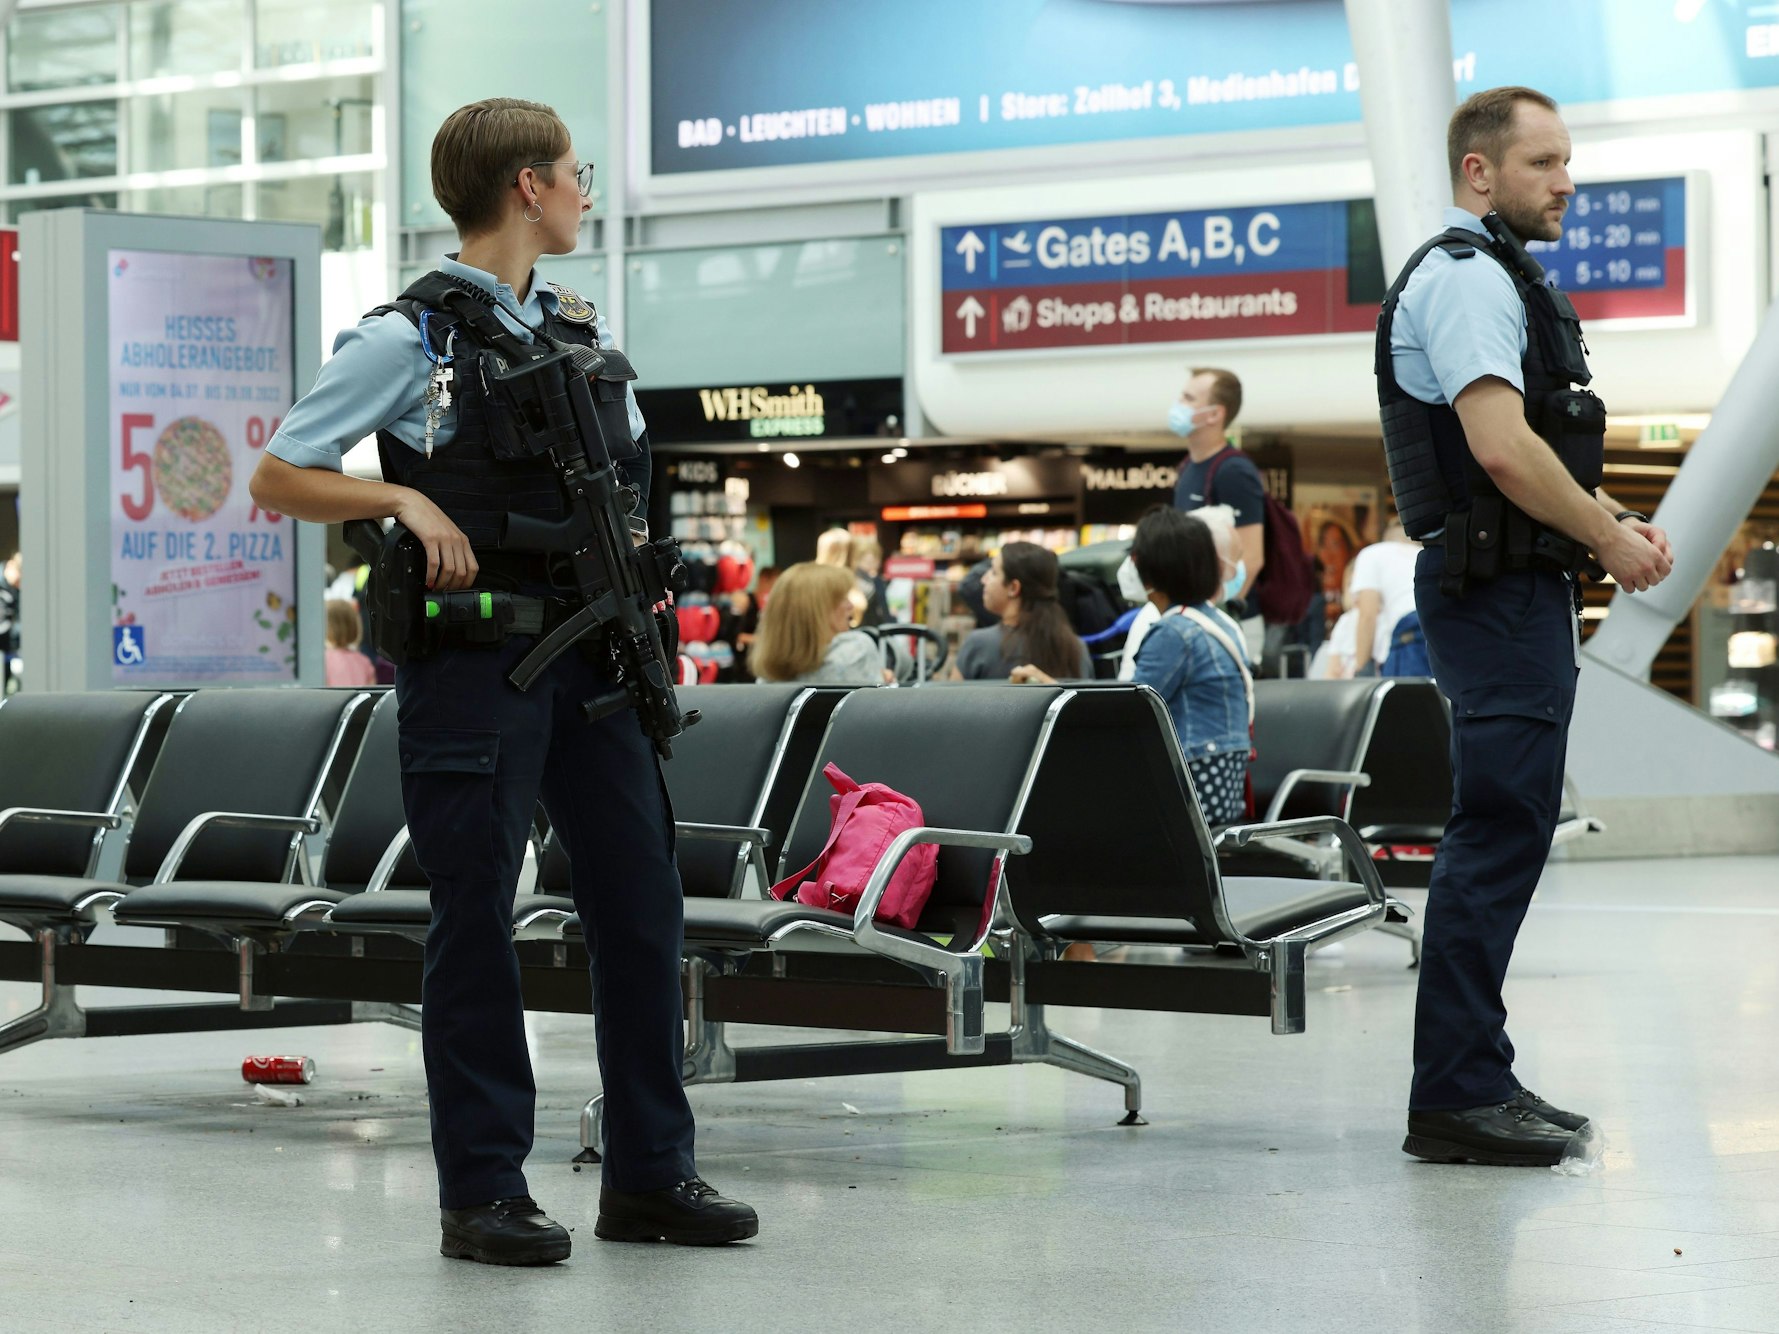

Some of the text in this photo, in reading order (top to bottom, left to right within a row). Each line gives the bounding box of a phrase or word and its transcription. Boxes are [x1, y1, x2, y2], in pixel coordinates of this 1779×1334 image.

[678, 117, 722, 148] BAD
[740, 107, 847, 143] LEUCHTEN
[865, 97, 960, 132] WOHNEN
[1002, 91, 1068, 121] Store:
[1074, 79, 1154, 115] Zollhof
[1158, 78, 1182, 112] 3,
[1187, 65, 1337, 105] Medienhafen
[1607, 190, 1631, 214] 10
[1036, 212, 1281, 269] Gates A,B,C
[1605, 224, 1631, 248] 20
[1607, 259, 1631, 283] 10
[1036, 288, 1298, 332] Shops & Restaurants
[165, 315, 236, 342] HEISSES
[699, 384, 825, 422] WHSmith
[750, 416, 825, 438] EXPRESS
[678, 460, 718, 483] KIDS
[121, 531, 283, 561] AUF DIE 2. PIZZA
